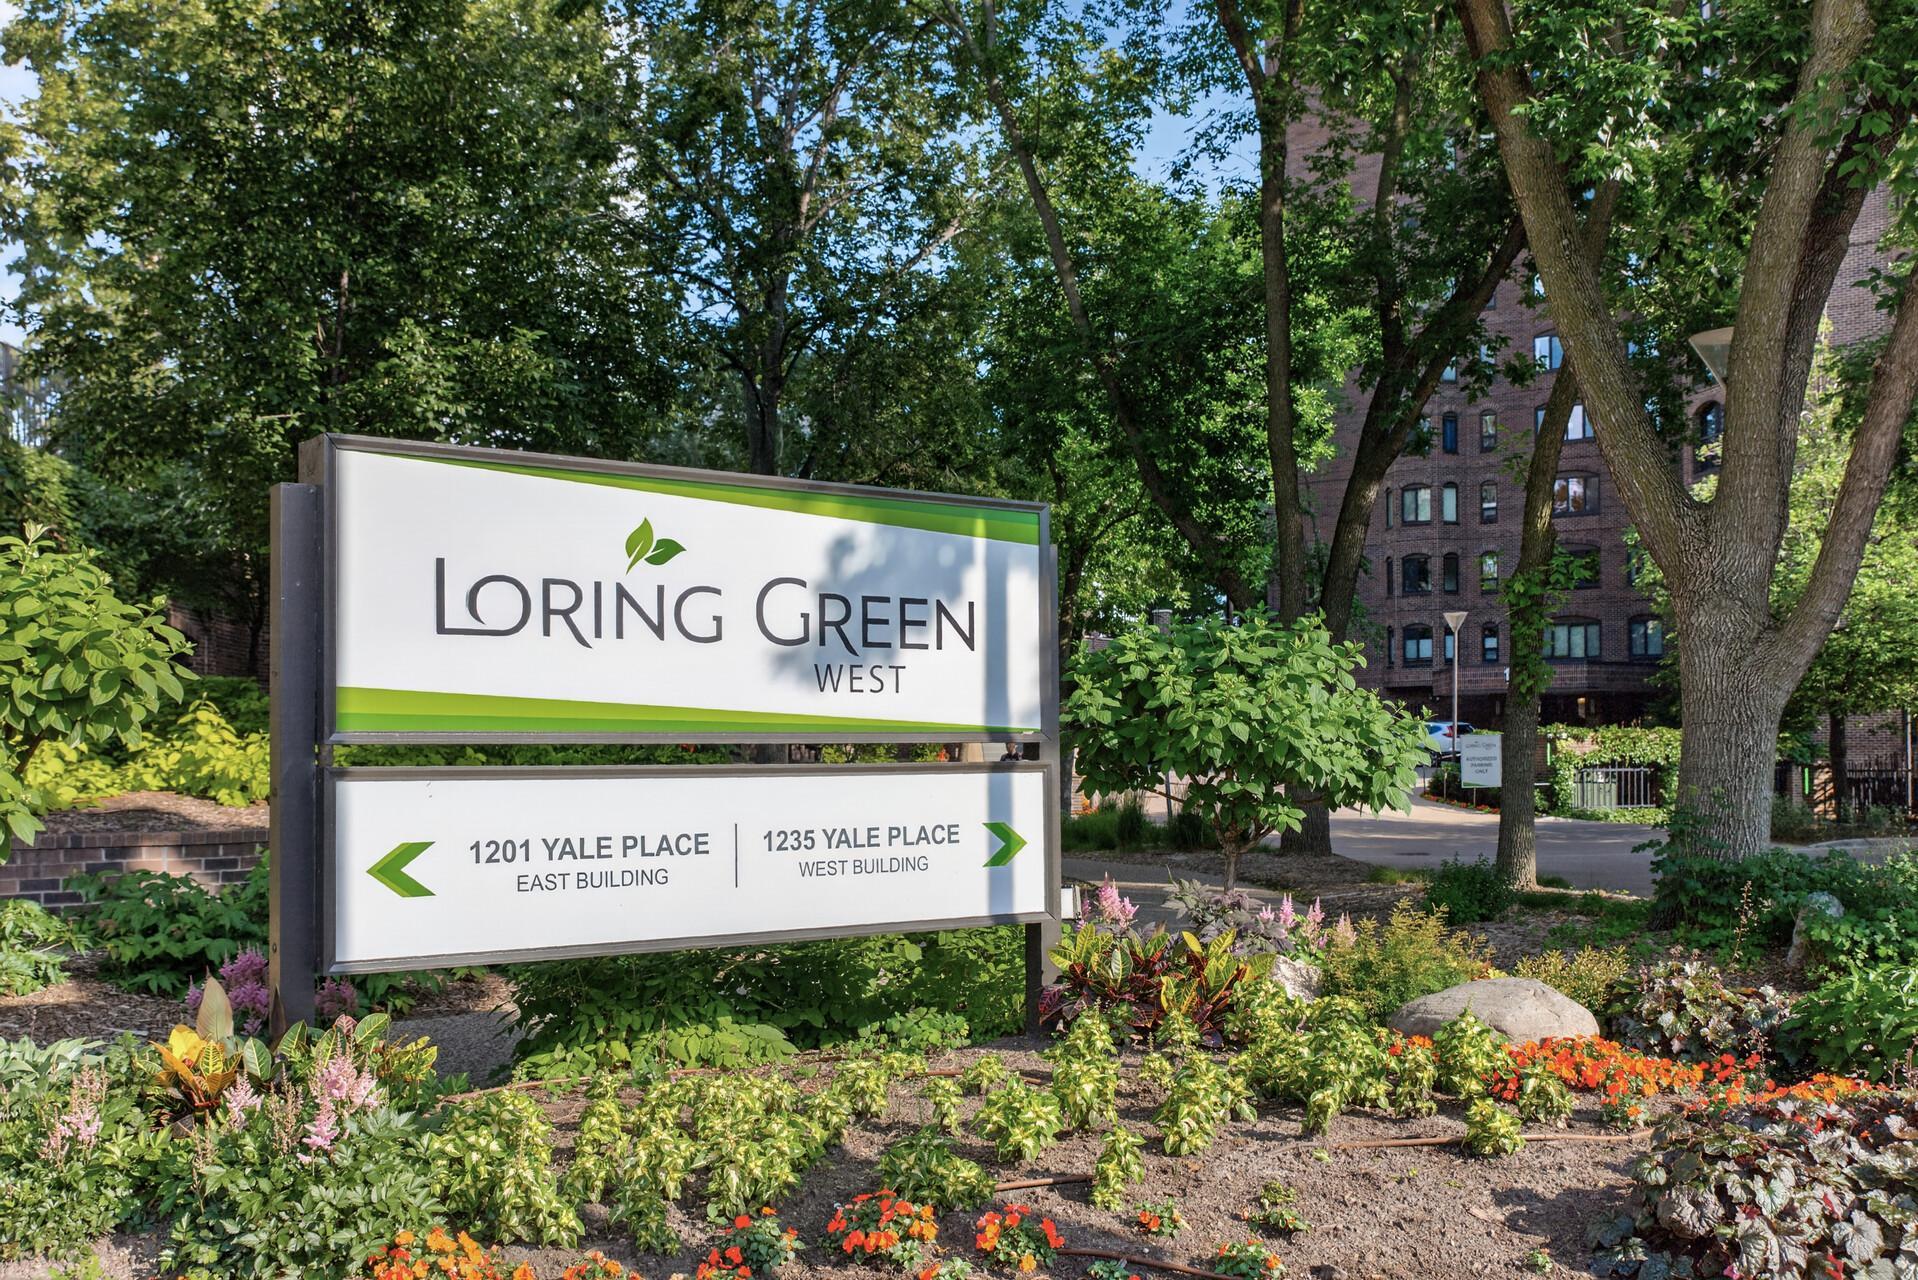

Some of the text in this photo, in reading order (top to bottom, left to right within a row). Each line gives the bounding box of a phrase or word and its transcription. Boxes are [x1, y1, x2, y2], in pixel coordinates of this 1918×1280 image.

[435, 557, 976, 658] LORING GREEN
[813, 663, 908, 694] WEST
[470, 833, 710, 864] 1201 YALE PLACE
[763, 824, 961, 852] 1235 YALE PLACE
[516, 868, 669, 892] EAST BUILDING
[798, 855, 930, 877] WEST BUILDING
